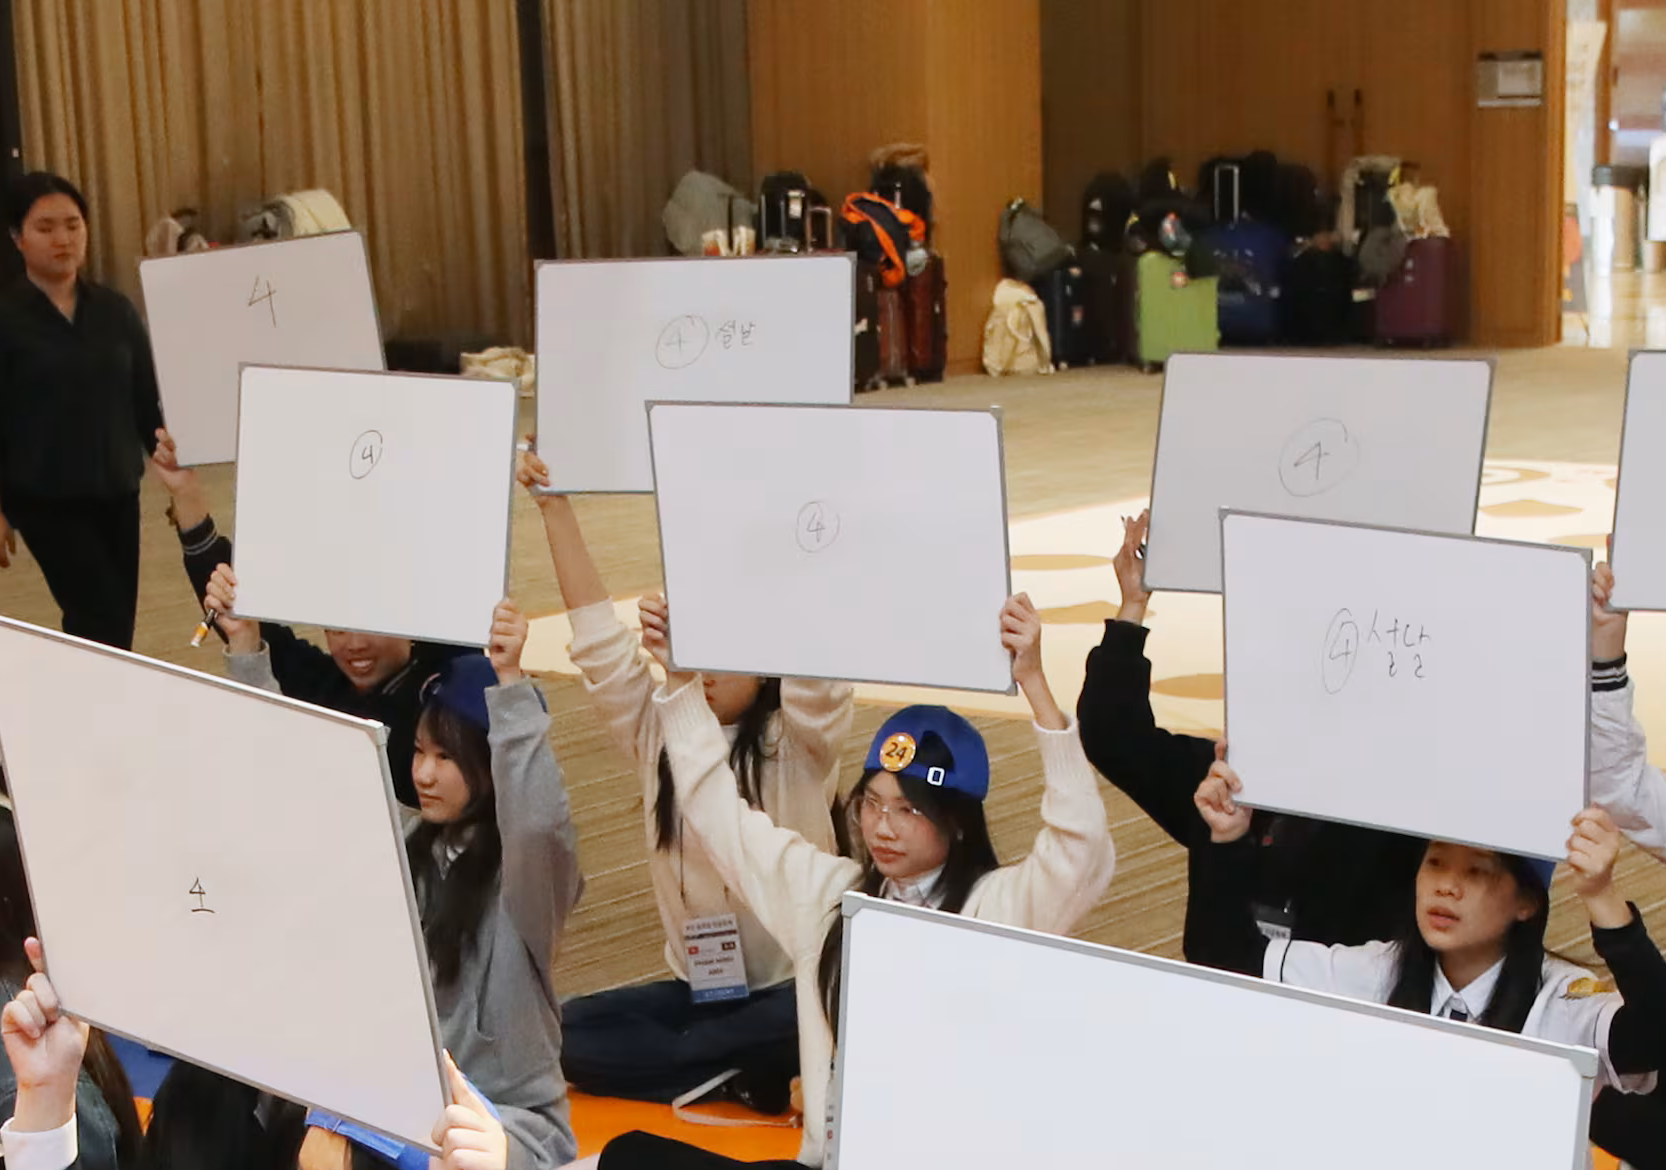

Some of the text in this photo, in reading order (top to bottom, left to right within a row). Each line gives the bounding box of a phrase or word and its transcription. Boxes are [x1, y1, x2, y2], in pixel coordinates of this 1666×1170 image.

[247, 275, 277, 328] 4
[1367, 607, 1431, 678] 설날
[886, 742, 908, 761] 24
